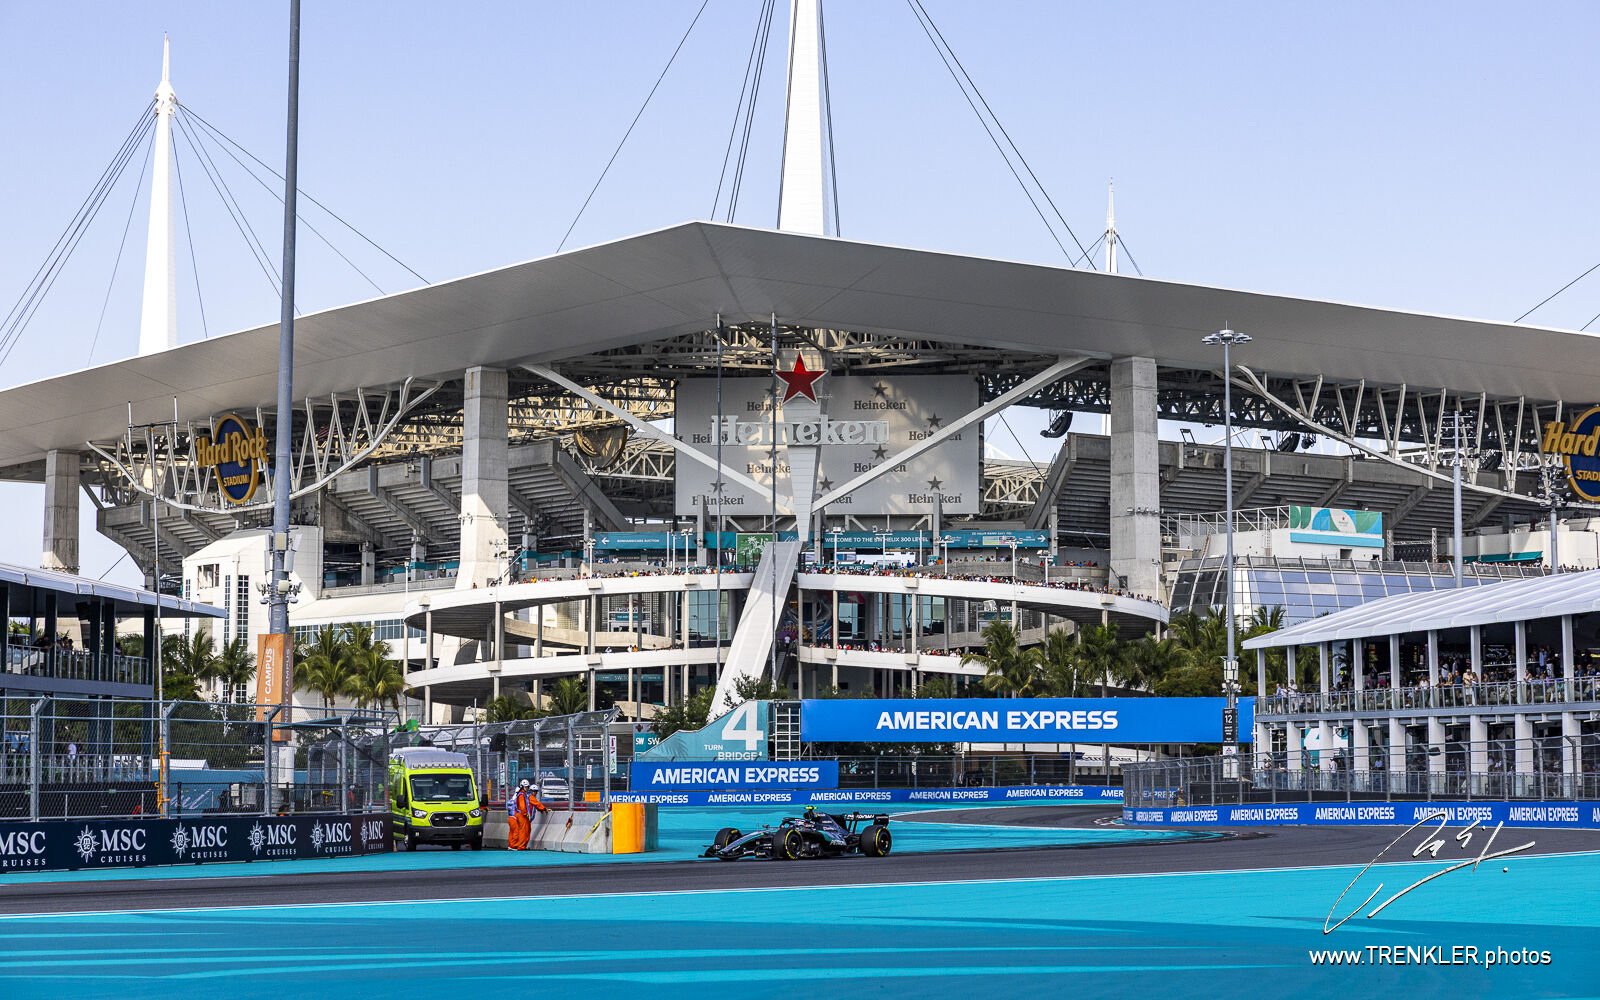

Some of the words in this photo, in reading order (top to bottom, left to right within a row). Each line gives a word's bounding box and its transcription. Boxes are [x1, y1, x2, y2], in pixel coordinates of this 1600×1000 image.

[854, 400, 906, 410] Heineken
[711, 415, 888, 446] Heineken
[1543, 421, 1600, 456] Hard
[196, 432, 230, 468] Hard
[231, 427, 269, 467] Rock
[223, 474, 249, 487] STADIUM
[691, 496, 745, 506] Hineken
[908, 494, 962, 504] Heinken
[265, 648, 273, 694] CAMPUS
[721, 700, 764, 751] 4
[875, 711, 998, 730] AMERICAN
[1006, 710, 1119, 730] EXPRESS
[1224, 715, 1233, 724] 12
[717, 751, 757, 761] BRIDGE
[651, 767, 740, 784] AMERICAN
[745, 767, 820, 783] EXPRESS
[650, 794, 689, 804] EXPRESS
[707, 793, 752, 803] AMERICAN
[753, 793, 792, 802] EXPRESS
[810, 792, 853, 801] AMERICAN
[854, 791, 892, 800] EXPRESS
[908, 791, 950, 800] AMERICAN
[952, 790, 989, 799] EXPRESS
[1006, 789, 1047, 798] AMERICAN
[1049, 788, 1084, 797] EXPRESS
[1170, 811, 1194, 822] AMERICAN
[1194, 810, 1218, 822] EXPRESS
[1230, 808, 1264, 821] AMERICAN
[1265, 808, 1298, 820] EXPRESS
[1315, 807, 1356, 820] AMERICAN
[1358, 806, 1395, 820] EXPRESS
[1457, 807, 1492, 821] EXPRESS
[1508, 807, 1547, 821] AMERICAN
[1548, 807, 1579, 822] EXPRESS
[191, 825, 228, 848] MSC
[267, 824, 296, 845] MSC
[325, 822, 352, 843] MSC
[368, 820, 384, 840] MSC
[0, 831, 46, 855] MSC
[100, 828, 146, 852] MSC
[191, 850, 228, 859] CRUISES
[267, 848, 297, 856] CRUISES
[325, 845, 352, 853] CRUISES
[2, 858, 46, 867] RUISES
[100, 854, 147, 863] CRUISES
